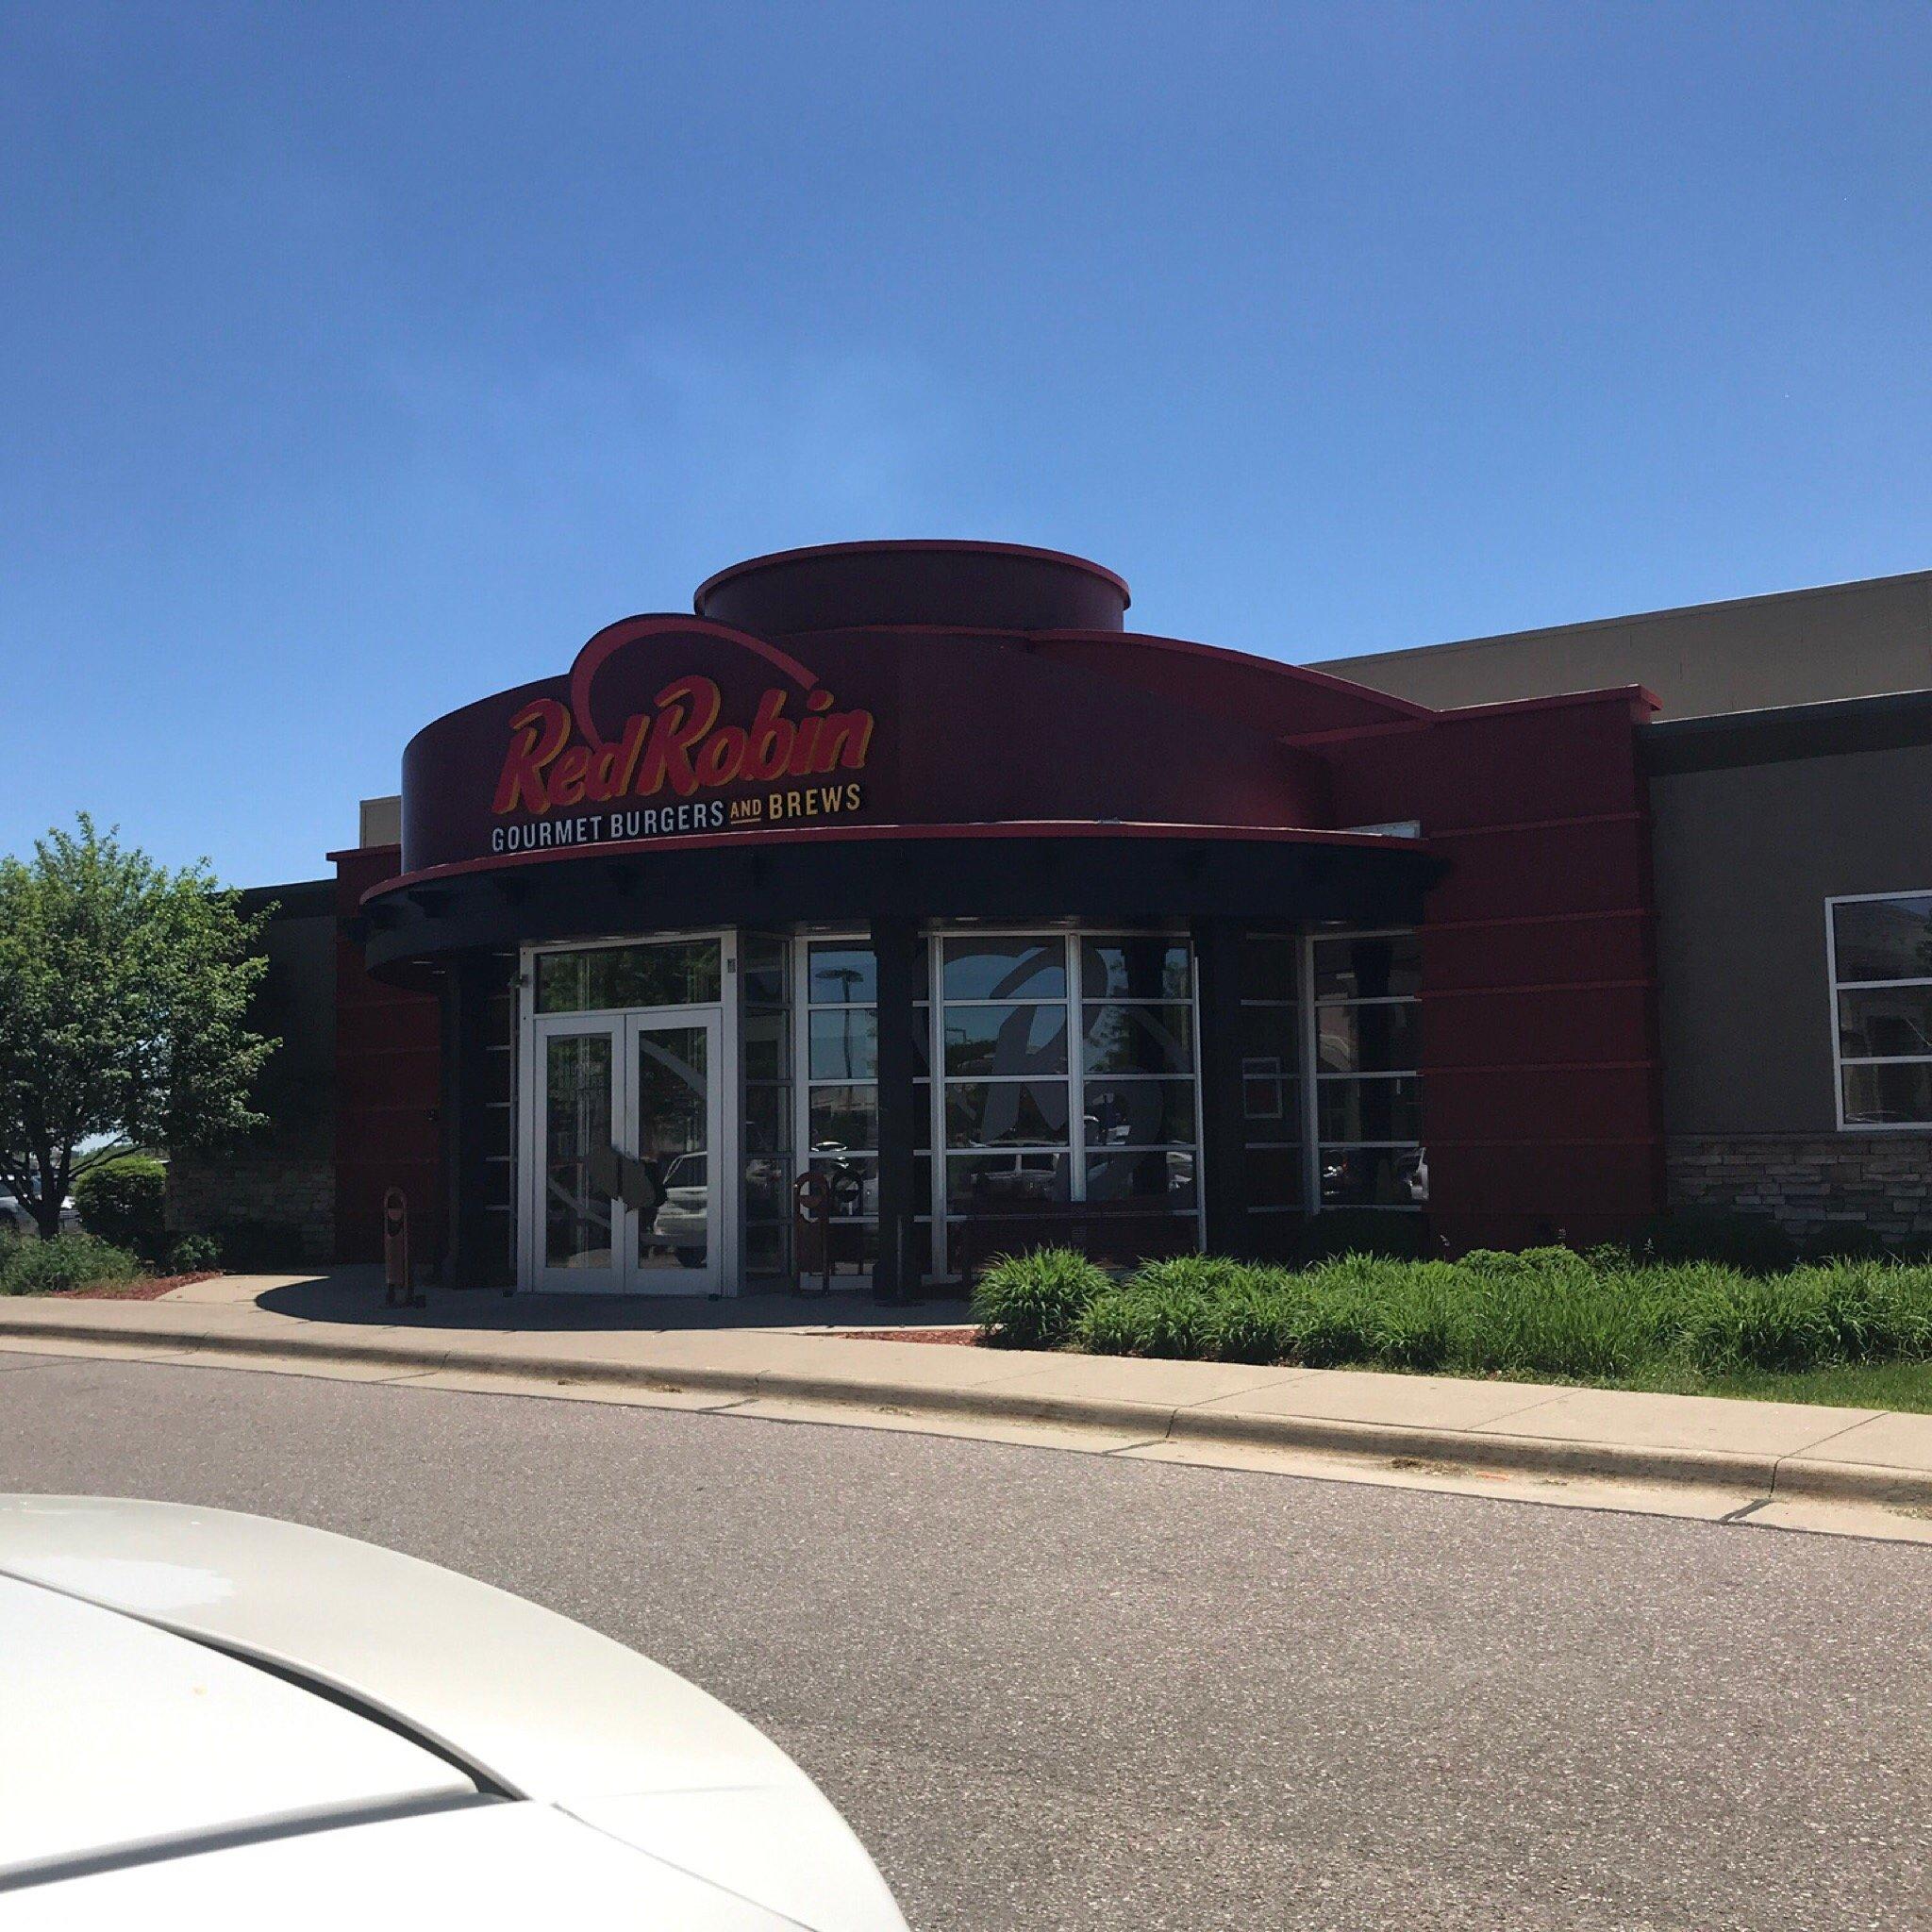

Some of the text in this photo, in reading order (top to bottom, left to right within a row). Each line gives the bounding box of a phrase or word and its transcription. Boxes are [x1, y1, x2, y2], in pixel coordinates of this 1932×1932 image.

[491, 783, 862, 853] GOURMET BURGERS AND BREWS
